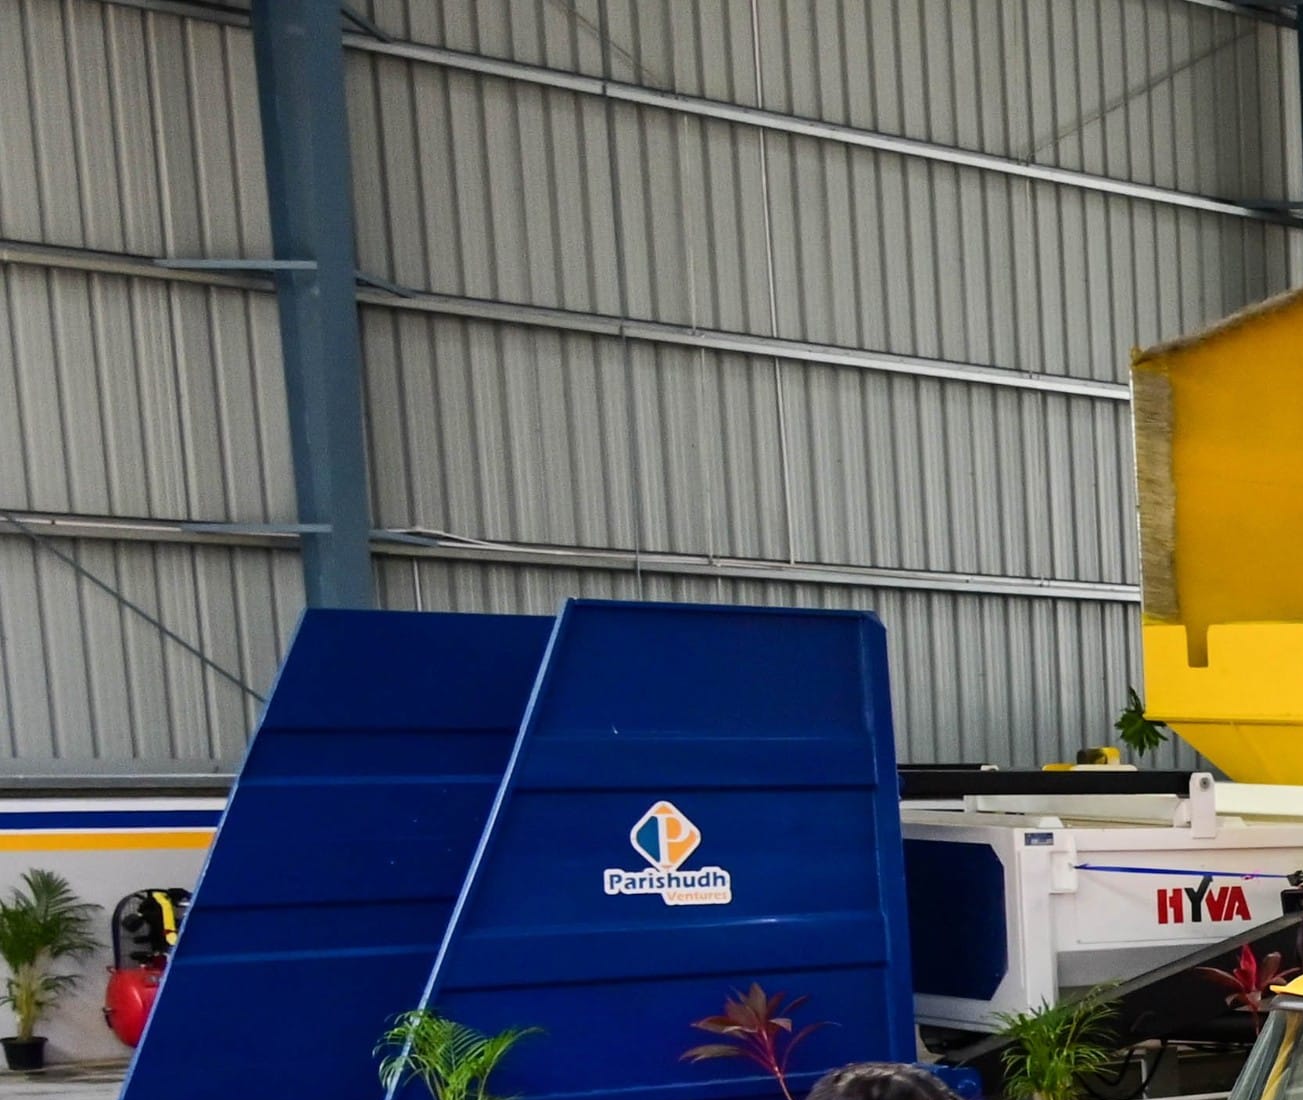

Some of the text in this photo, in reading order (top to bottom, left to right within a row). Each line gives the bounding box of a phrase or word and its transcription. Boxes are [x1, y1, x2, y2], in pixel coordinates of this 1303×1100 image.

[608, 871, 727, 890] Parishudh
[665, 890, 728, 902] Ventures
[1157, 874, 1252, 924] HYVA
